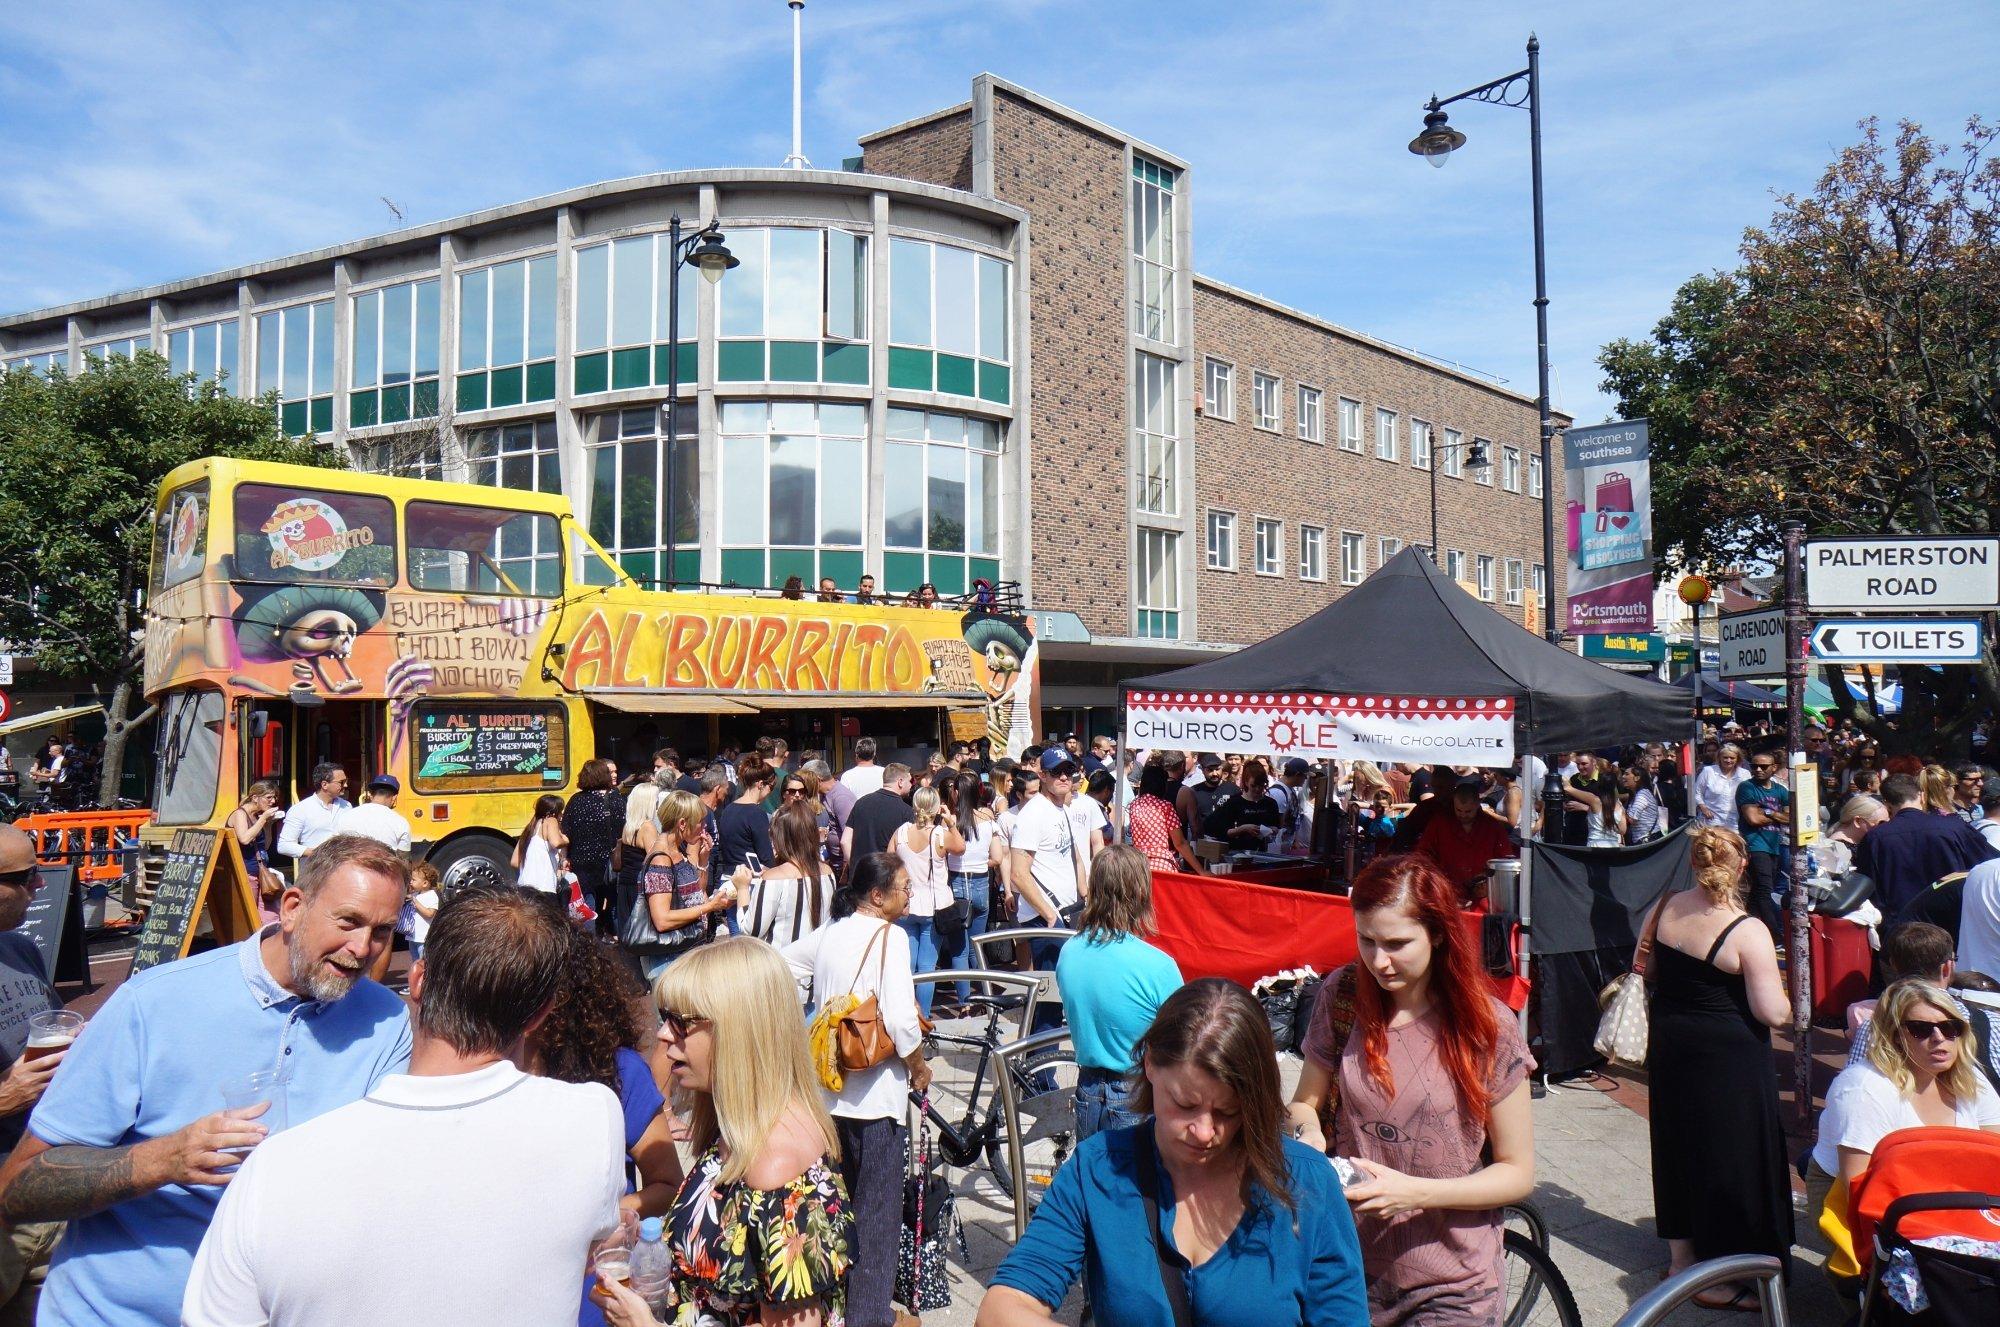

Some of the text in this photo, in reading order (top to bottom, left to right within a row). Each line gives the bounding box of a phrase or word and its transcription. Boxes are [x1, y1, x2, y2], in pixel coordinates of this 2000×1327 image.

[1573, 431, 1637, 448] welcome to
[1579, 446, 1632, 460] southsea
[298, 526, 374, 561] BURRITO
[1819, 547, 1988, 567] PALMERSTON
[1867, 578, 1938, 596] ROAD
[390, 602, 498, 628] BURRITO
[1572, 602, 1647, 617] Portsmouth
[1584, 618, 1600, 626] great
[1601, 616, 1635, 624] waterfront
[1635, 616, 1647, 624] city
[1722, 617, 1785, 642] CLARENDON
[470, 636, 531, 662] BOWL
[1604, 634, 1626, 649] Austin
[1630, 637, 1648, 653] Wyatt
[1856, 630, 1965, 650] TOILETS
[1738, 648, 1767, 667] ROAD
[479, 714, 532, 728] BURRITO
[427, 732, 468, 742] BURRITO
[1134, 720, 1254, 742] CHURROS
[1267, 716, 1338, 753] OLE
[1359, 733, 1495, 748] WITH CHOCOLATE
[475, 761, 509, 770] EXTRAS 1
[163, 861, 192, 882] BURRITO
